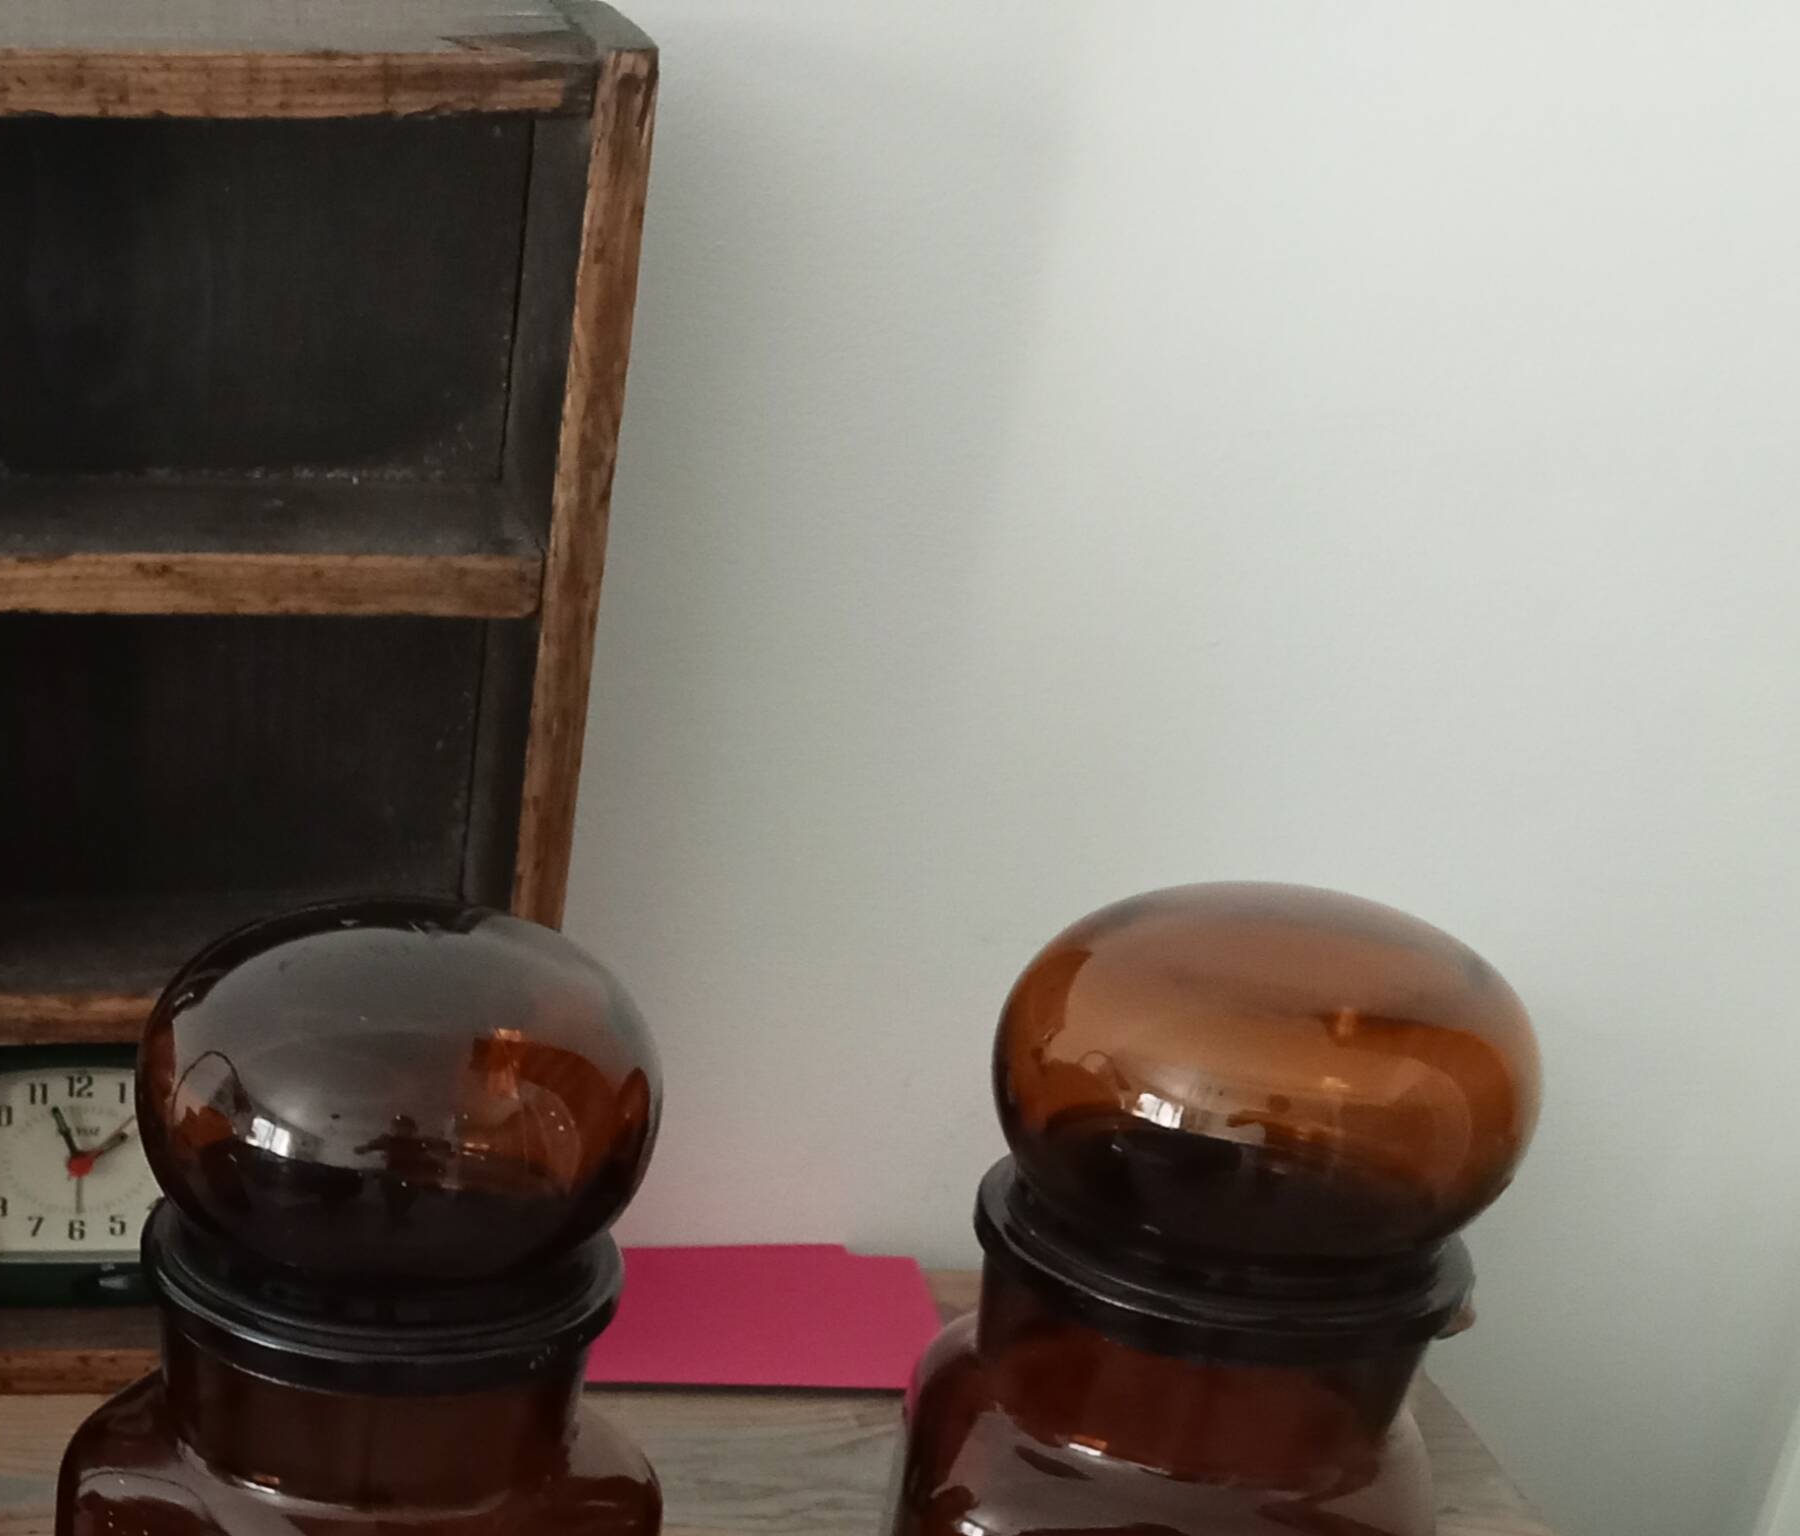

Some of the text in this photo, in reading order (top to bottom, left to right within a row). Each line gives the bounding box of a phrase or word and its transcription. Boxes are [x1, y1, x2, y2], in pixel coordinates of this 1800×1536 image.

[27, 1082, 48, 1105] 11
[66, 1074, 94, 1098] 12
[117, 1082, 126, 1104] 1
[27, 1216, 44, 1238] 7
[67, 1219, 85, 1241] 6
[108, 1214, 126, 1236] 5
